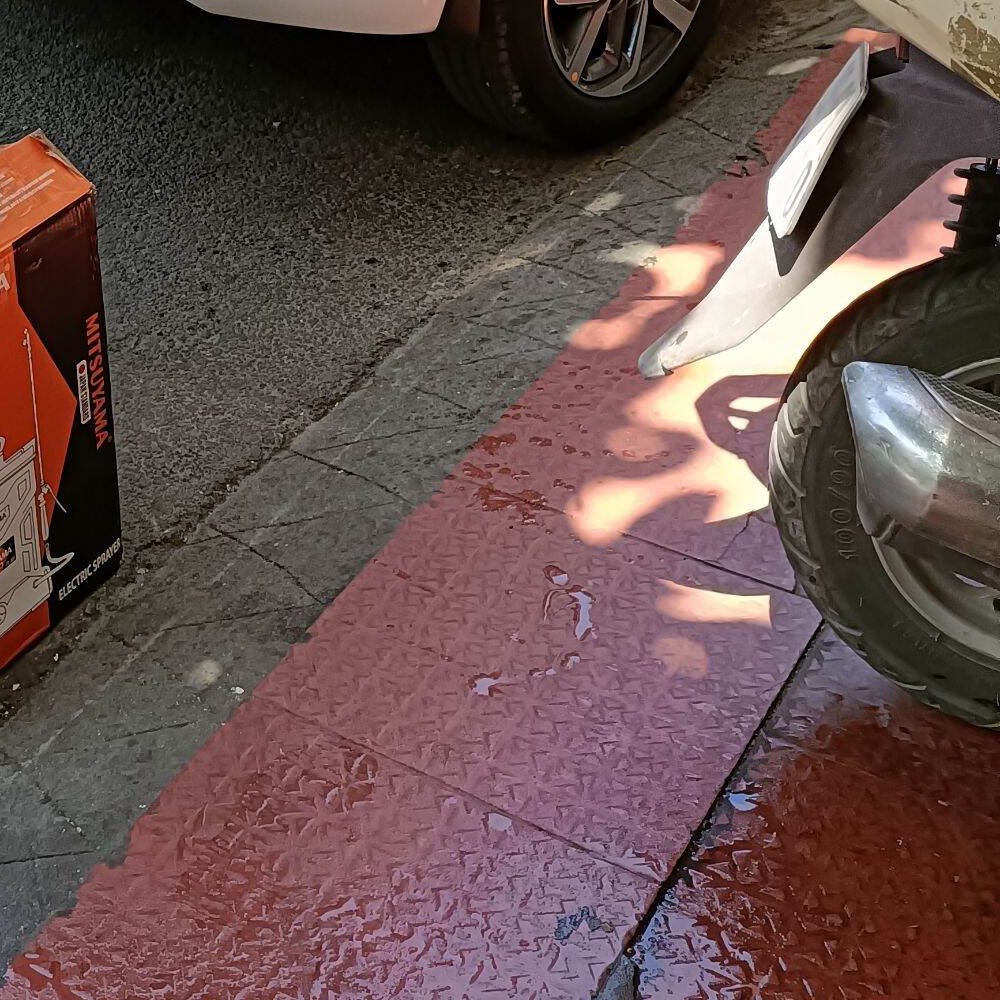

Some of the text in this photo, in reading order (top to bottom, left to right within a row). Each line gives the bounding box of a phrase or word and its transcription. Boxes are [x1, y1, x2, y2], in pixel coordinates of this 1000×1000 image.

[85, 312, 108, 450] MITSUYAMA
[59, 537, 121, 601] ELECTRIC SPRAYER
